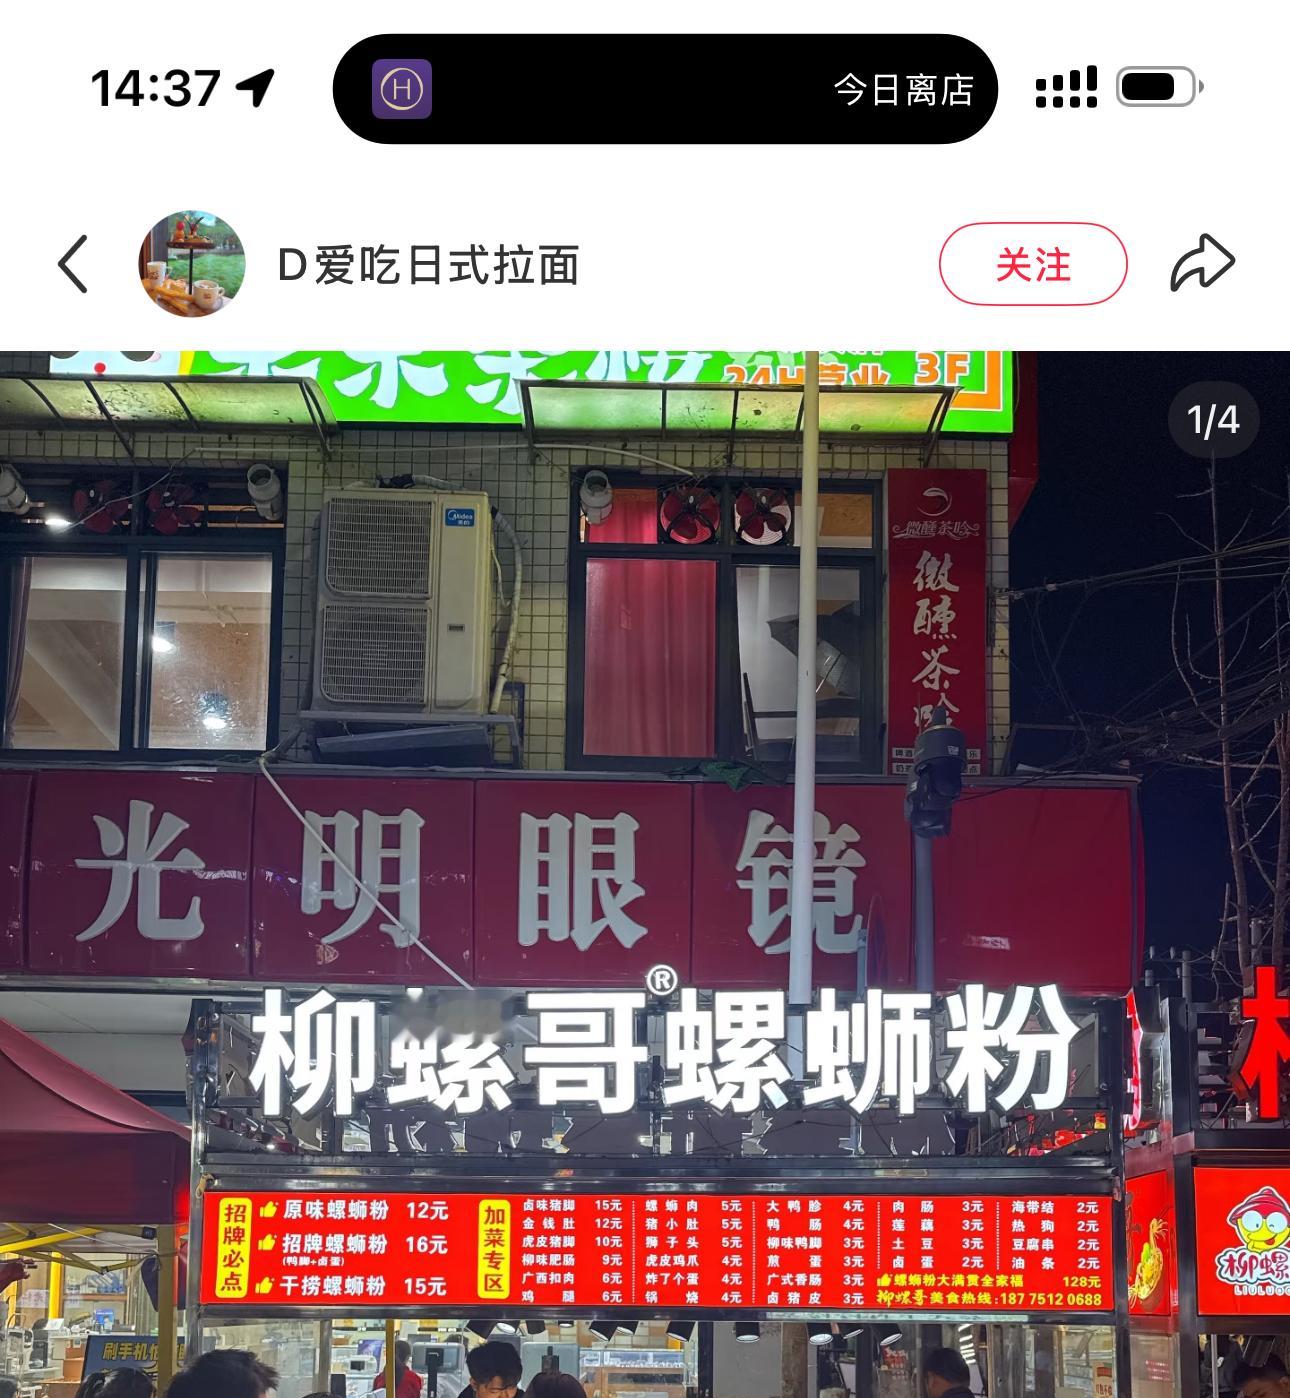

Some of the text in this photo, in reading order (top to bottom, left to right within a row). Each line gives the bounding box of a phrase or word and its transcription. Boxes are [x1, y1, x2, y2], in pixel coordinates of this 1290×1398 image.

[914, 351, 969, 382] 3F
[74, 798, 868, 955] 光明眼镜
[284, 1199, 448, 1220] 原味螺蛳粉 12元
[596, 1200, 622, 1211] 15元
[722, 1200, 742, 1211] 5元
[843, 1200, 864, 1211] 4元
[963, 1201, 983, 1212] 3元
[1077, 1202, 1098, 1213] 2元
[596, 1218, 622, 1229] 12元
[722, 1218, 742, 1230] 5元
[844, 1219, 864, 1230] 4元
[962, 1219, 984, 1231] 3元
[1078, 1220, 1099, 1232] 2元
[282, 1233, 448, 1254] 招牌螺蛳粉 16元
[596, 1236, 622, 1247] 10元
[722, 1237, 742, 1248] 5元
[844, 1237, 864, 1249] 3元
[962, 1238, 984, 1249] 3元
[1078, 1239, 1099, 1250] 2元
[219, 1202, 246, 1293] 招牌必点
[482, 1205, 508, 1293] 加菜专区
[603, 1254, 622, 1265] 9元
[722, 1255, 742, 1266] 4元
[844, 1256, 864, 1267] 3元
[962, 1256, 984, 1268] 2元
[1078, 1258, 1100, 1269] 2元
[603, 1273, 622, 1284] 6元
[722, 1273, 742, 1285] 4元
[844, 1274, 864, 1286] 3元
[1062, 1276, 1102, 1289] 128元
[280, 1276, 446, 1296] 干捞螺蛳粉 15元
[603, 1291, 622, 1302] 6元
[721, 1292, 741, 1303] 4元
[844, 1293, 864, 1305] 3元
[1000, 1293, 1025, 1305] 187
[1029, 1293, 1063, 1305] 7512
[1067, 1294, 1102, 1306] 0688
